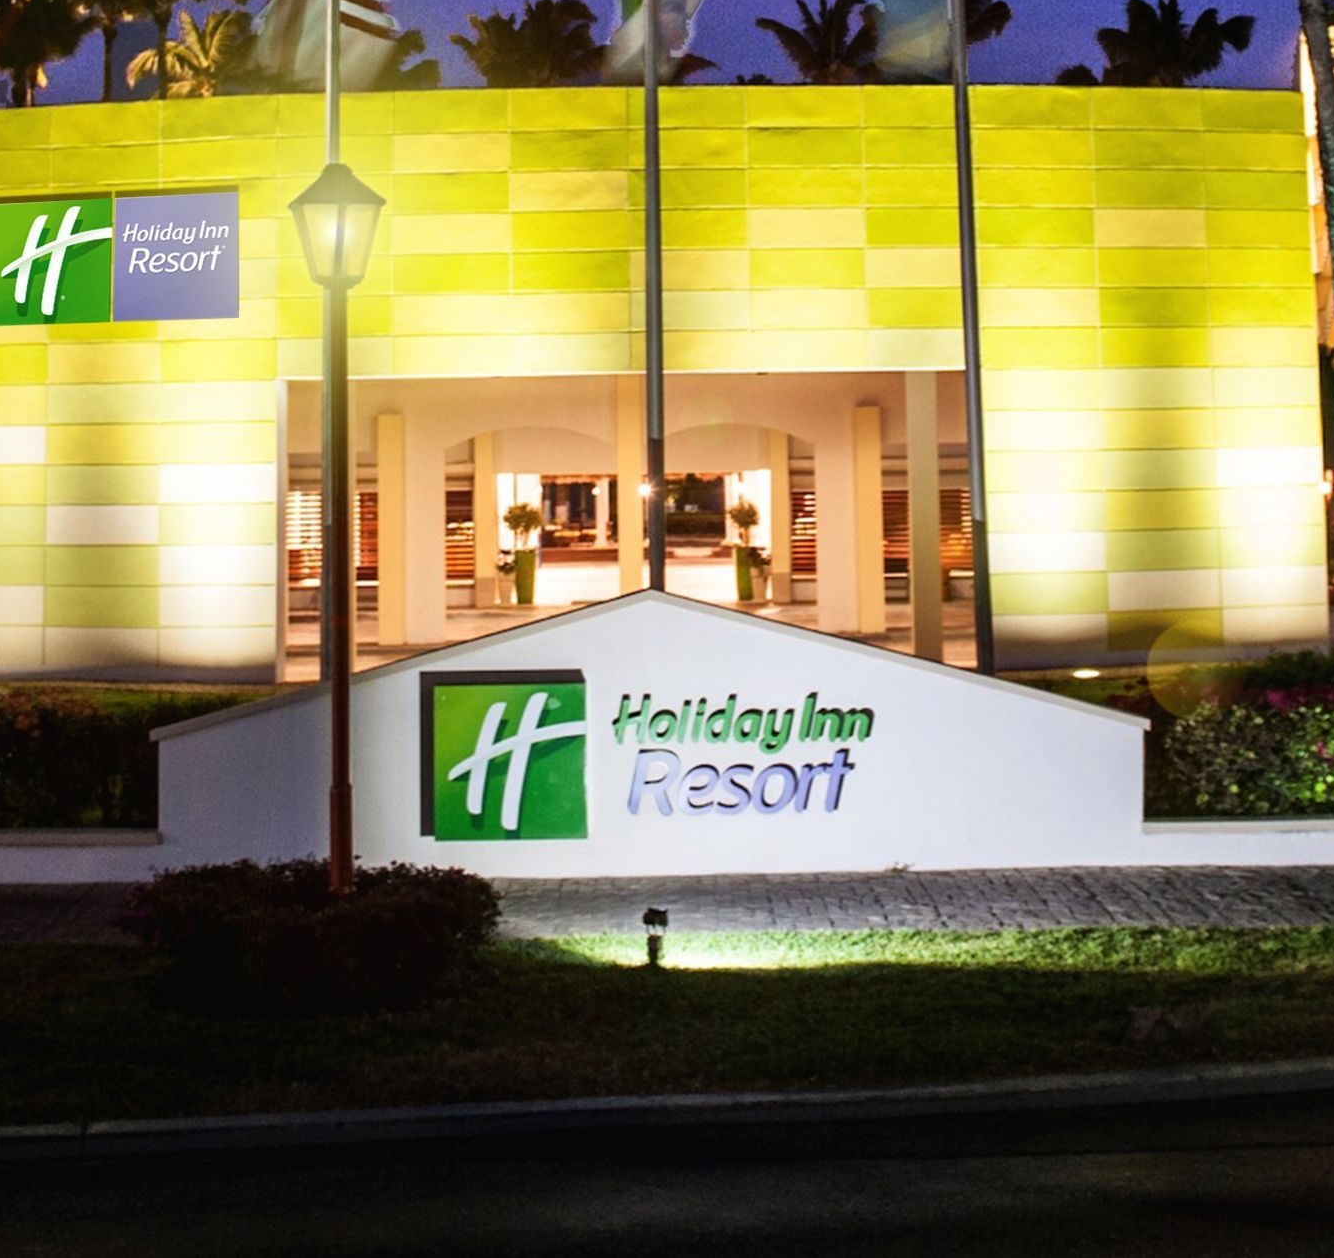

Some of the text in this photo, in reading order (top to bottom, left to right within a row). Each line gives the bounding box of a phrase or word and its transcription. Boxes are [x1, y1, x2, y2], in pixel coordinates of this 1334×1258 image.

[122, 220, 229, 245] Holiday Inn
[128, 245, 222, 274] Resort
[611, 691, 875, 754] Holiday Inn
[626, 748, 856, 817] Resort
